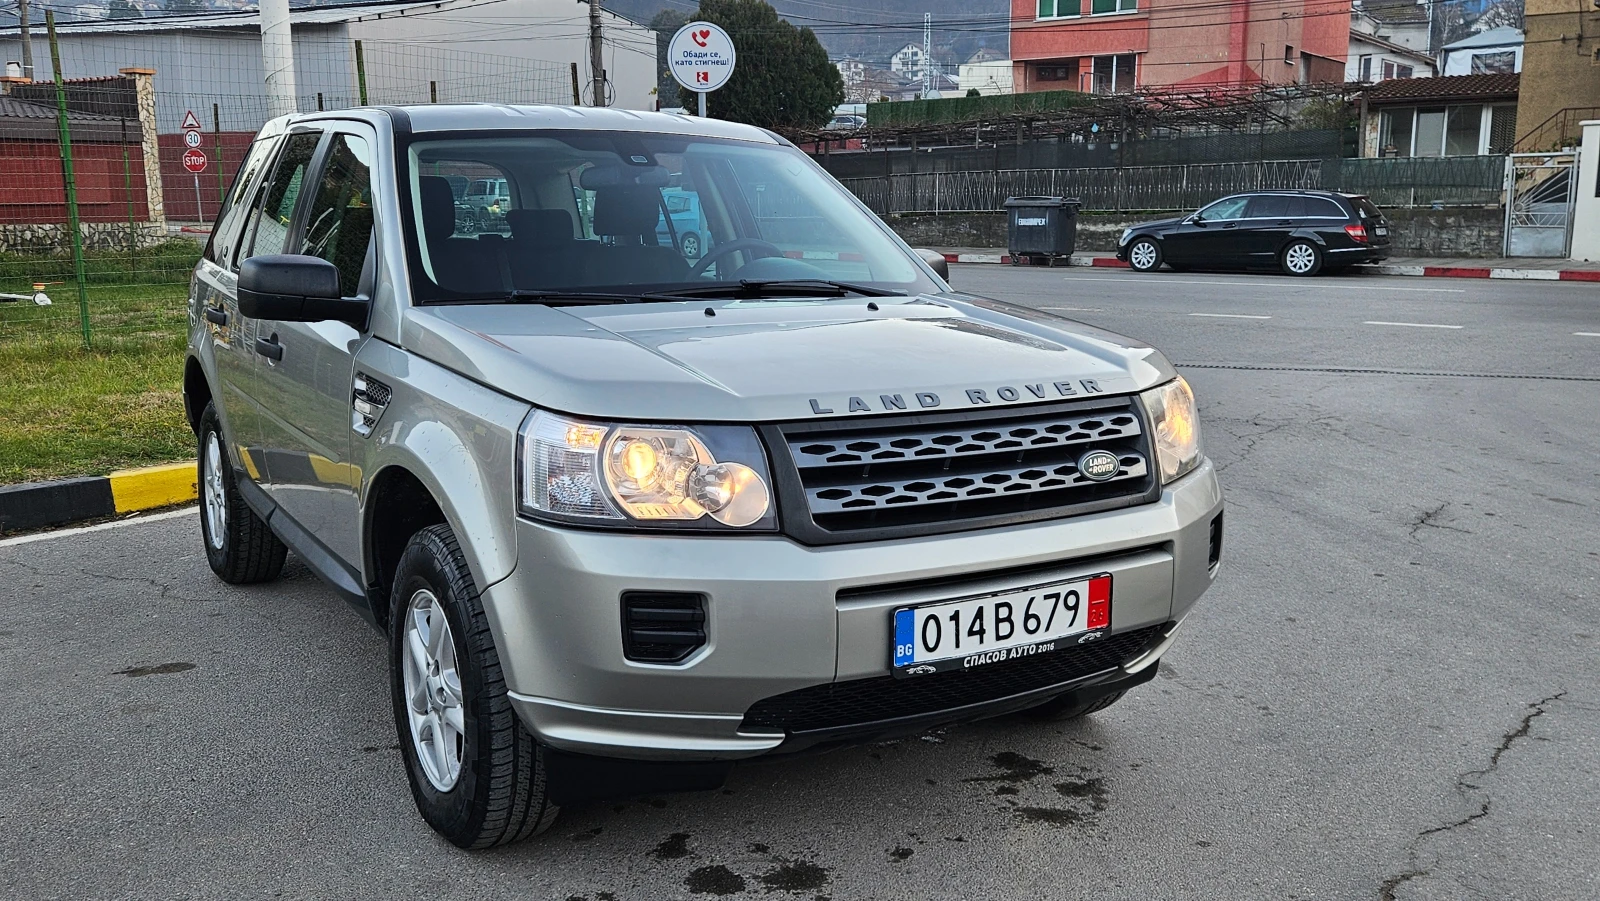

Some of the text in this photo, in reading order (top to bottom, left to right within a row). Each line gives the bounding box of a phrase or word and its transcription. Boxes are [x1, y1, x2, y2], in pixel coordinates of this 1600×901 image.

[683, 50, 708, 59] Обади
[695, 58, 729, 66] стигнеш!
[187, 134, 199, 144] 30
[185, 156, 205, 166] STOP
[809, 378, 1103, 414] LAND ROVER
[1089, 457, 1107, 467] LAND
[1092, 463, 1114, 474] ROVER
[896, 644, 913, 658] BG
[963, 642, 1055, 668] СПАСОВ АУТО 2016
